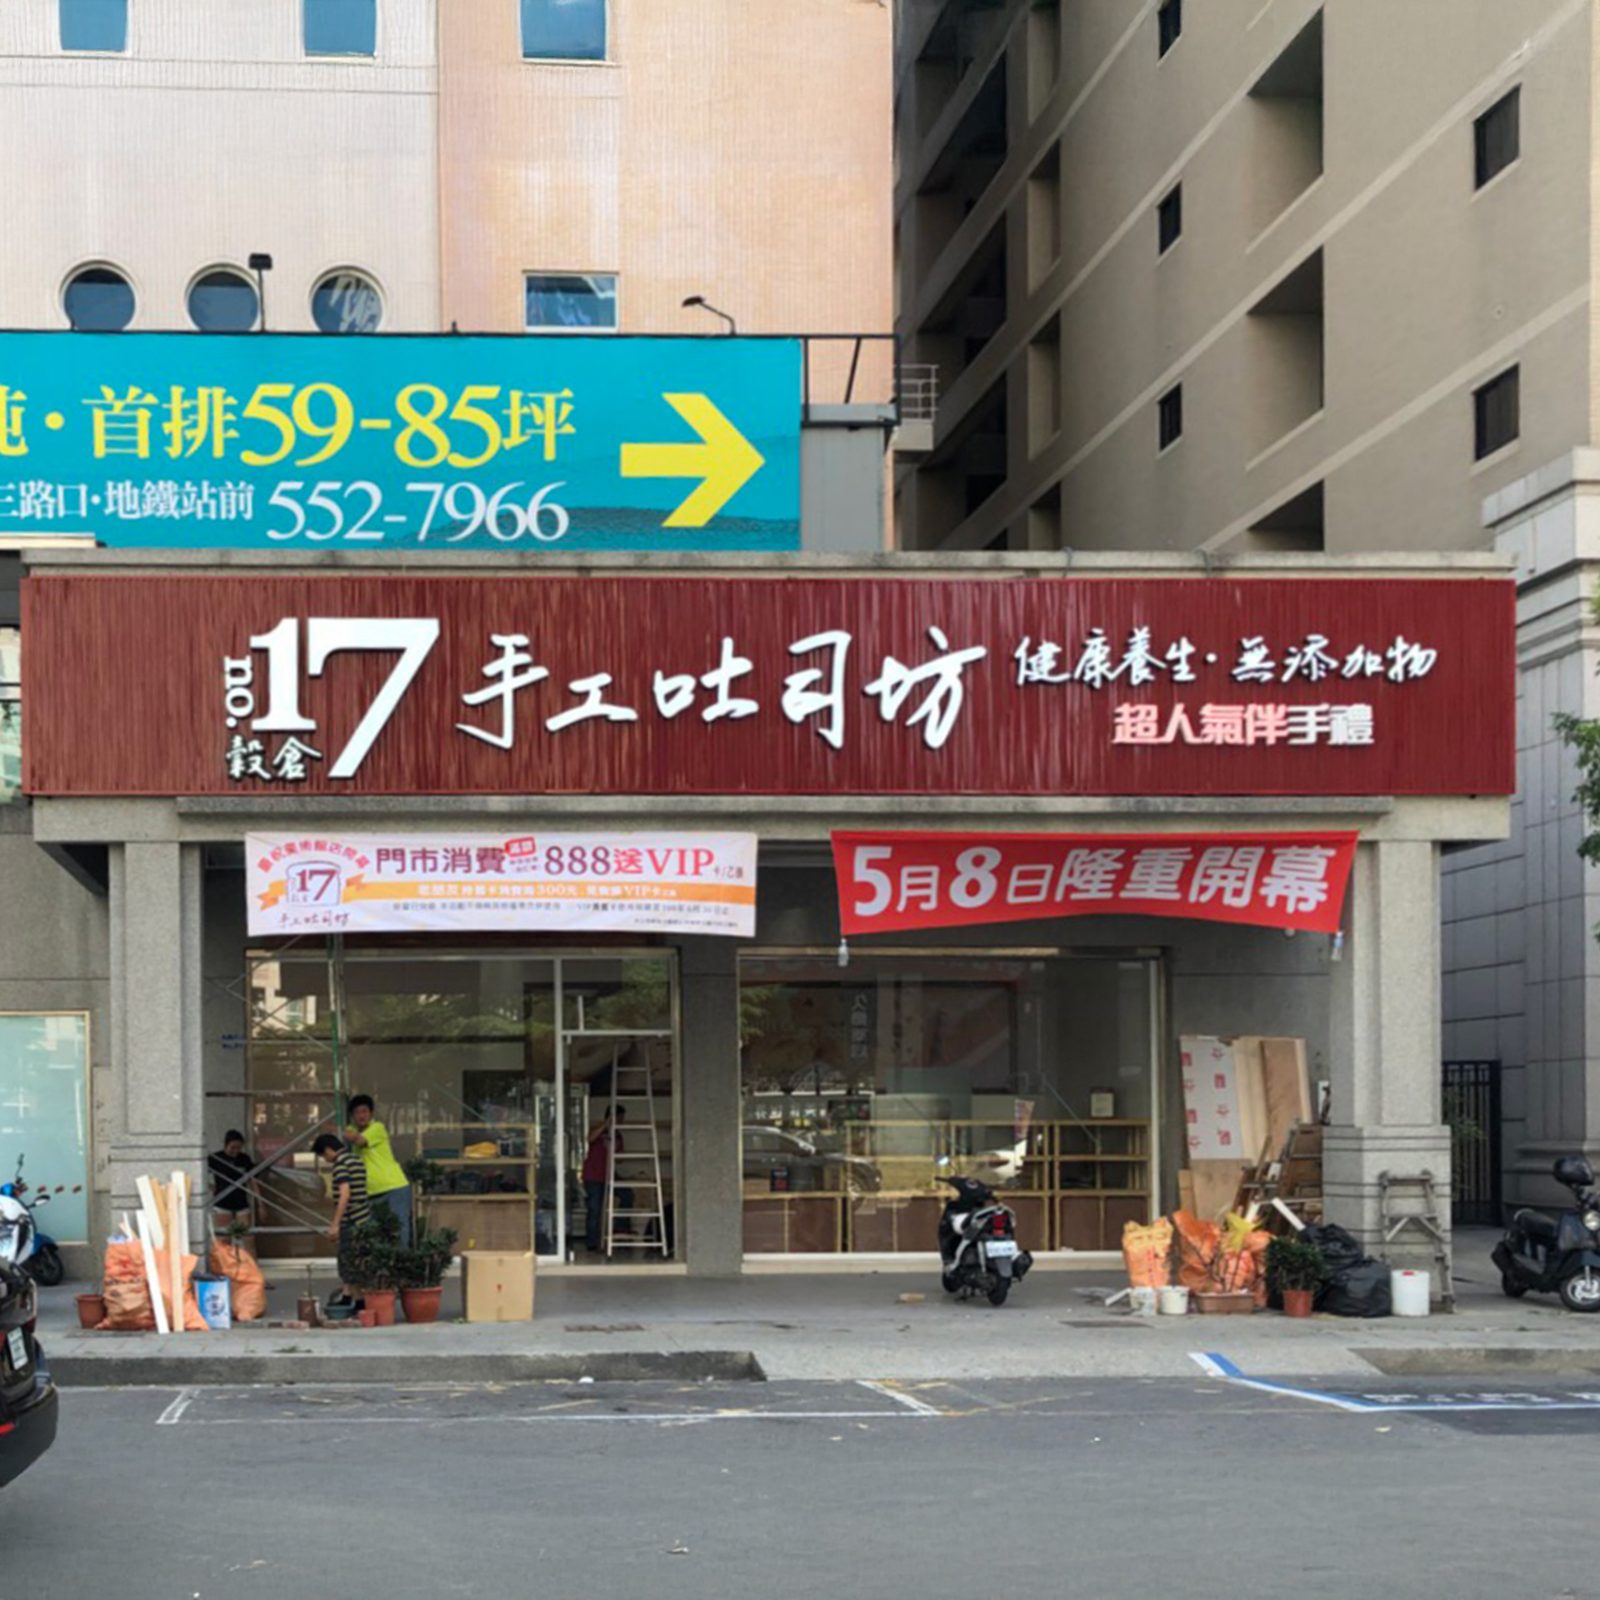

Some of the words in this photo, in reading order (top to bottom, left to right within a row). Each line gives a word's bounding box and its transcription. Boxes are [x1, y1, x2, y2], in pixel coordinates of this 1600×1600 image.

[267, 481, 569, 541] 552-7966
[249, 617, 440, 778] 17
[456, 626, 987, 749] 手工吐司坊
[1111, 702, 1375, 746] 超人氣伴手禮
[297, 869, 338, 901] 17
[376, 846, 506, 875] 門市消費
[852, 845, 1338, 918] 5月8日隆重開幕
